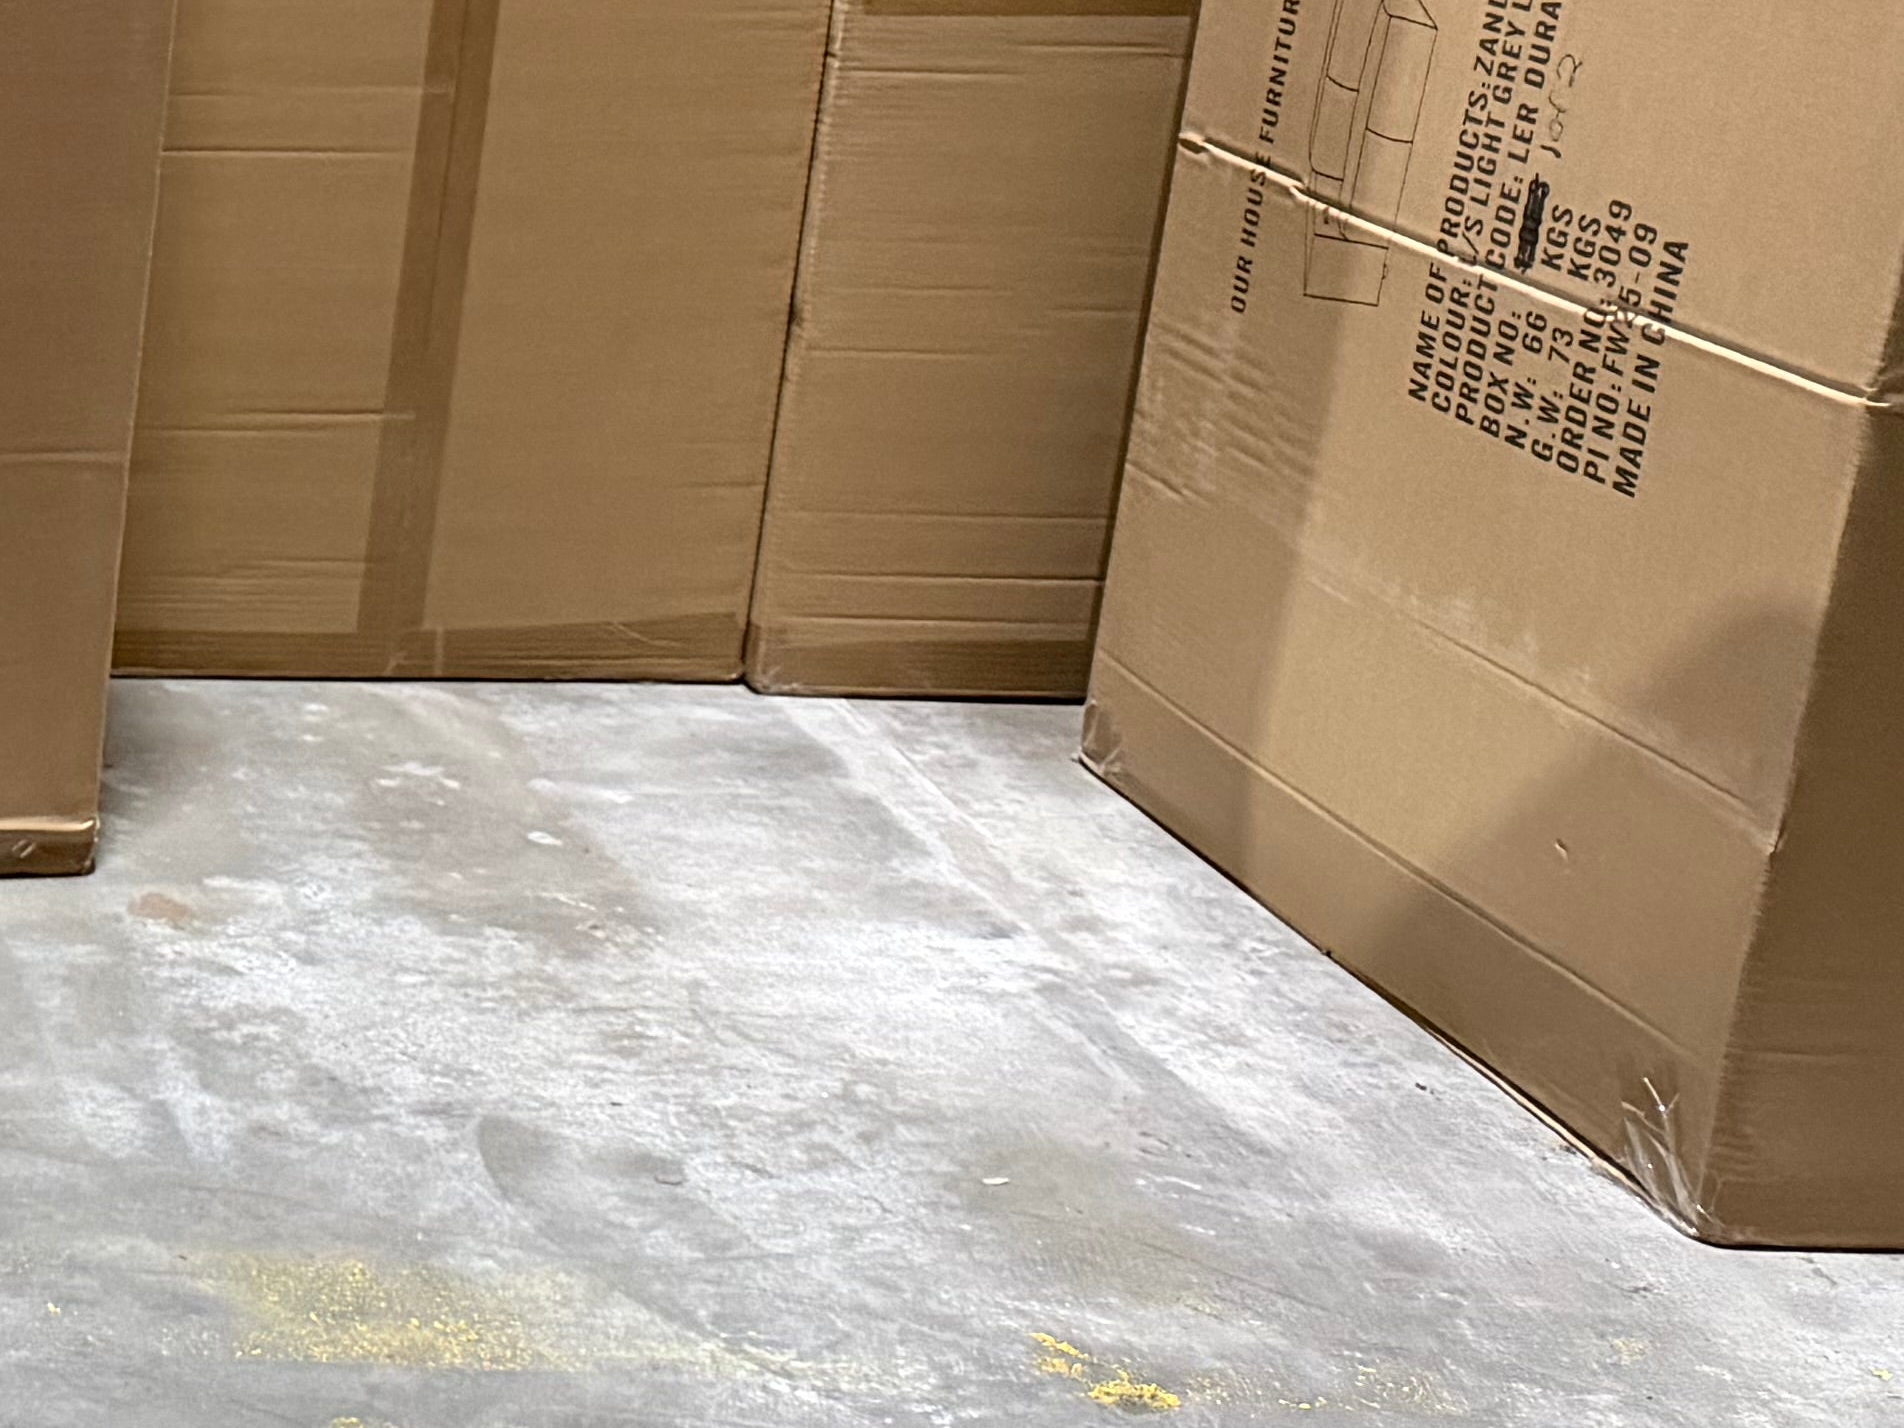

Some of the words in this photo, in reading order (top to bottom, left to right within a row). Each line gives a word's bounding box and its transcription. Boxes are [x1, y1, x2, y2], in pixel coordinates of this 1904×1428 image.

[1241, 151, 1271, 247] HOUSE
[1432, 279, 1473, 413] COLOUR:
[1470, 111, 1506, 207] LIGHT
[1492, 20, 1526, 105] GREY
[1231, 256, 1253, 313] OUR
[1455, 272, 1499, 426] PRODUCT
[1485, 175, 1524, 270] CODE:
[1508, 102, 1539, 164] LER
[1567, 214, 1601, 282] KGS
[1408, 310, 1440, 402] NAME
[1425, 262, 1447, 305] OF
[1504, 376, 1537, 450] N.W:
[1522, 310, 1547, 354] 66
[1540, 204, 1573, 271] KGS
[1642, 241, 1689, 347] CHINA
[1493, 310, 1522, 366] NO:
[1547, 327, 1573, 364] 73
[1631, 354, 1661, 394] IN
[1479, 371, 1509, 438] BOX
[1531, 390, 1564, 462] G.W:
[1557, 360, 1596, 474] ORDER
[1583, 447, 1610, 485] PI
[1612, 398, 1651, 498] MADE
